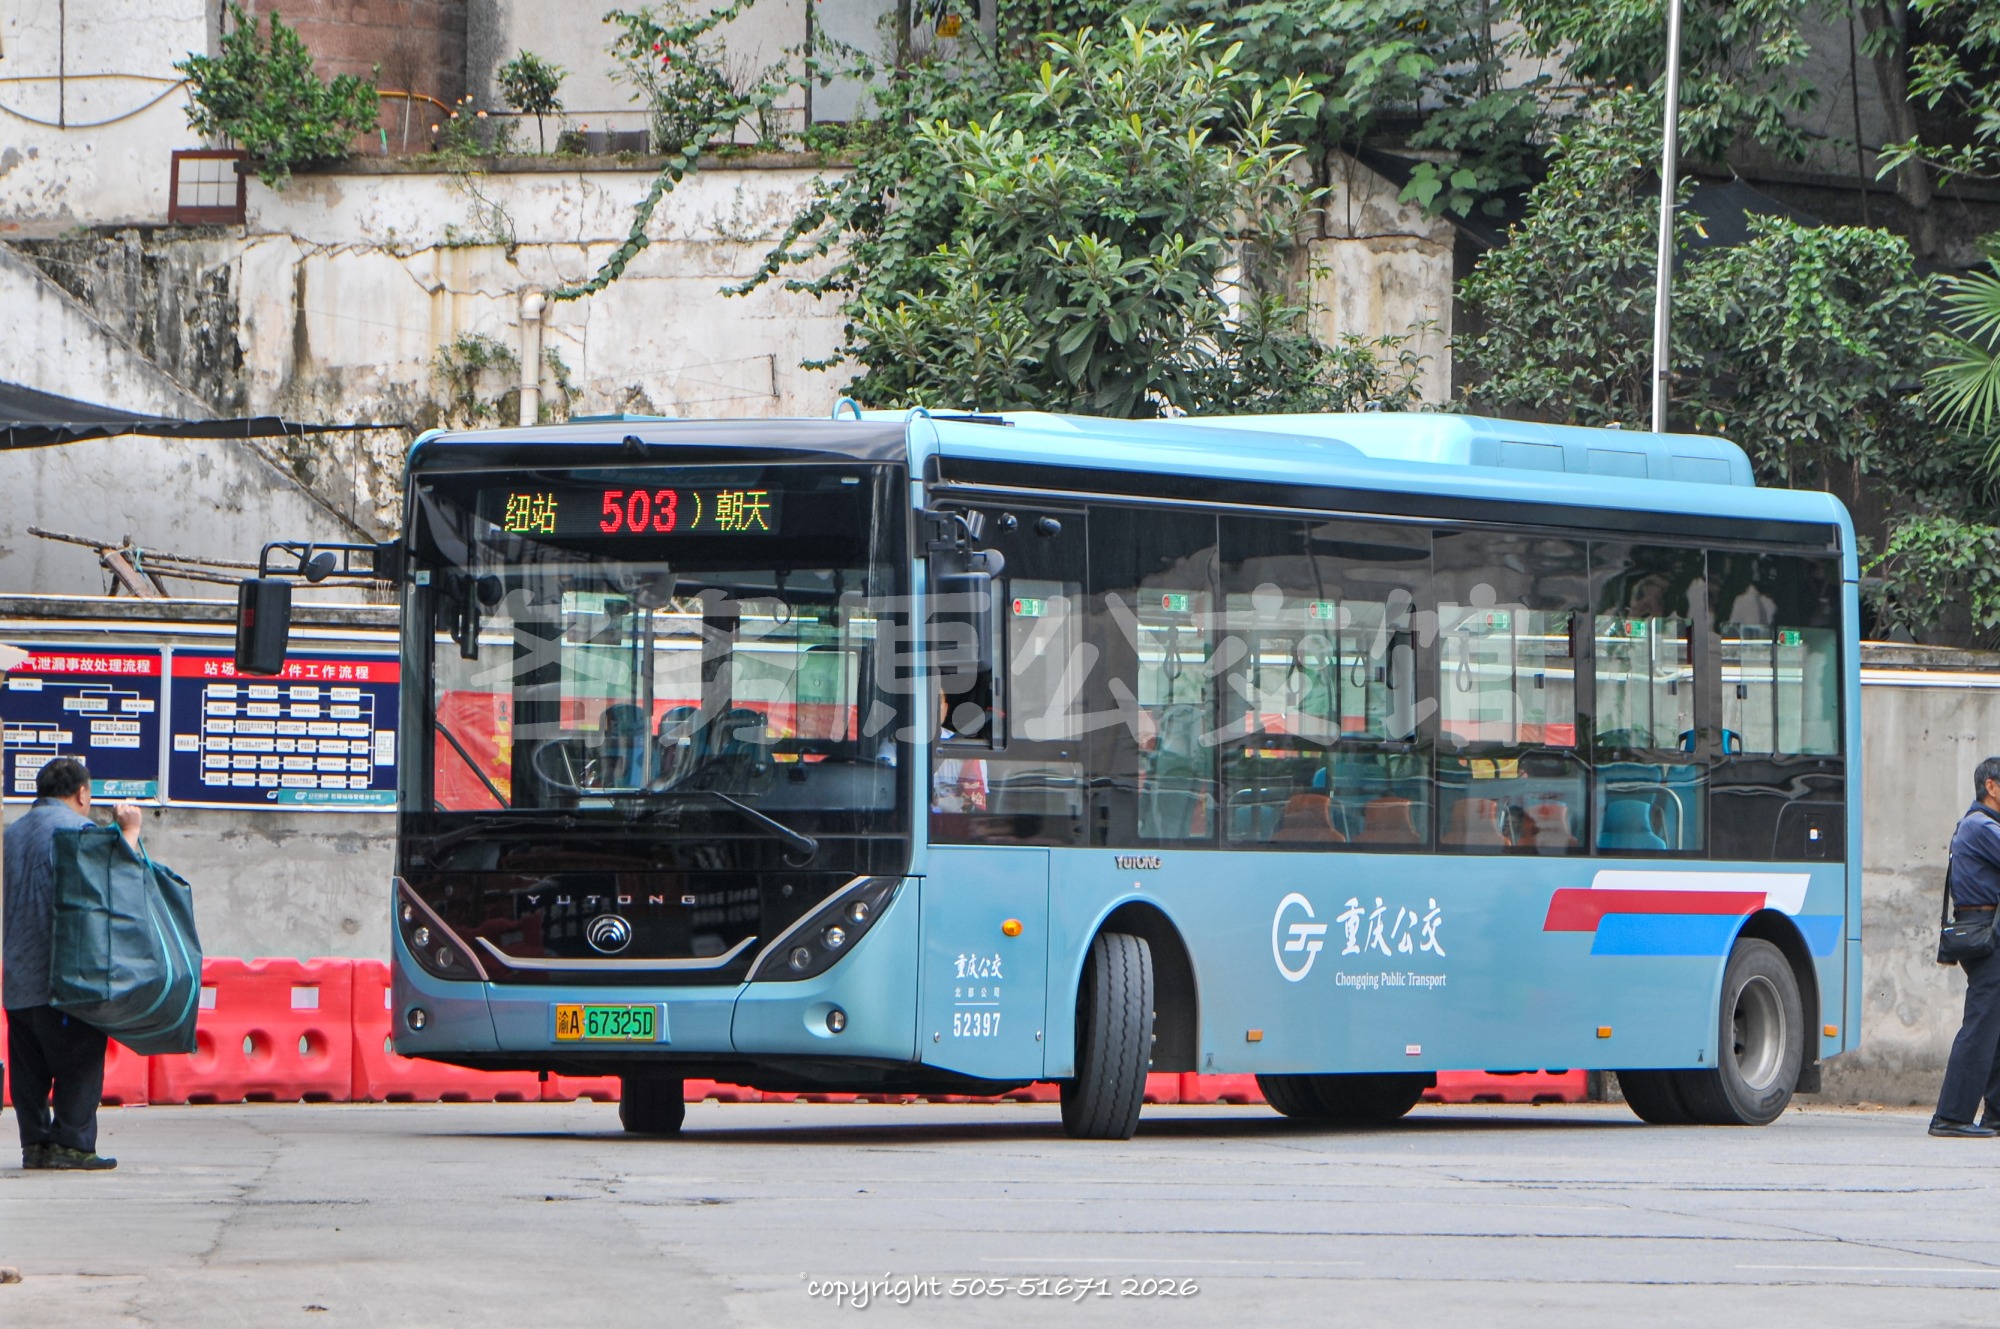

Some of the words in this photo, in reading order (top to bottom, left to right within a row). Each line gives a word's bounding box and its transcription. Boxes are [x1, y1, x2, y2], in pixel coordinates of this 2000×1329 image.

[505, 492, 558, 533] 纽站
[599, 490, 679, 533] 503
[10, 656, 151, 673] 气泄漏事故处理流程
[204, 661, 369, 679] 站场件工作流程
[1114, 854, 1163, 870] YUTONG
[527, 894, 696, 905] YUTONG
[1336, 897, 1446, 957] 重庆公交
[954, 953, 1003, 979] 重庆公交
[1335, 972, 1379, 990] Chongqing
[1381, 972, 1406, 986] Public
[1407, 972, 1447, 990] Transport
[955, 986, 1000, 998] 北部公司
[953, 1012, 1001, 1037] 52397
